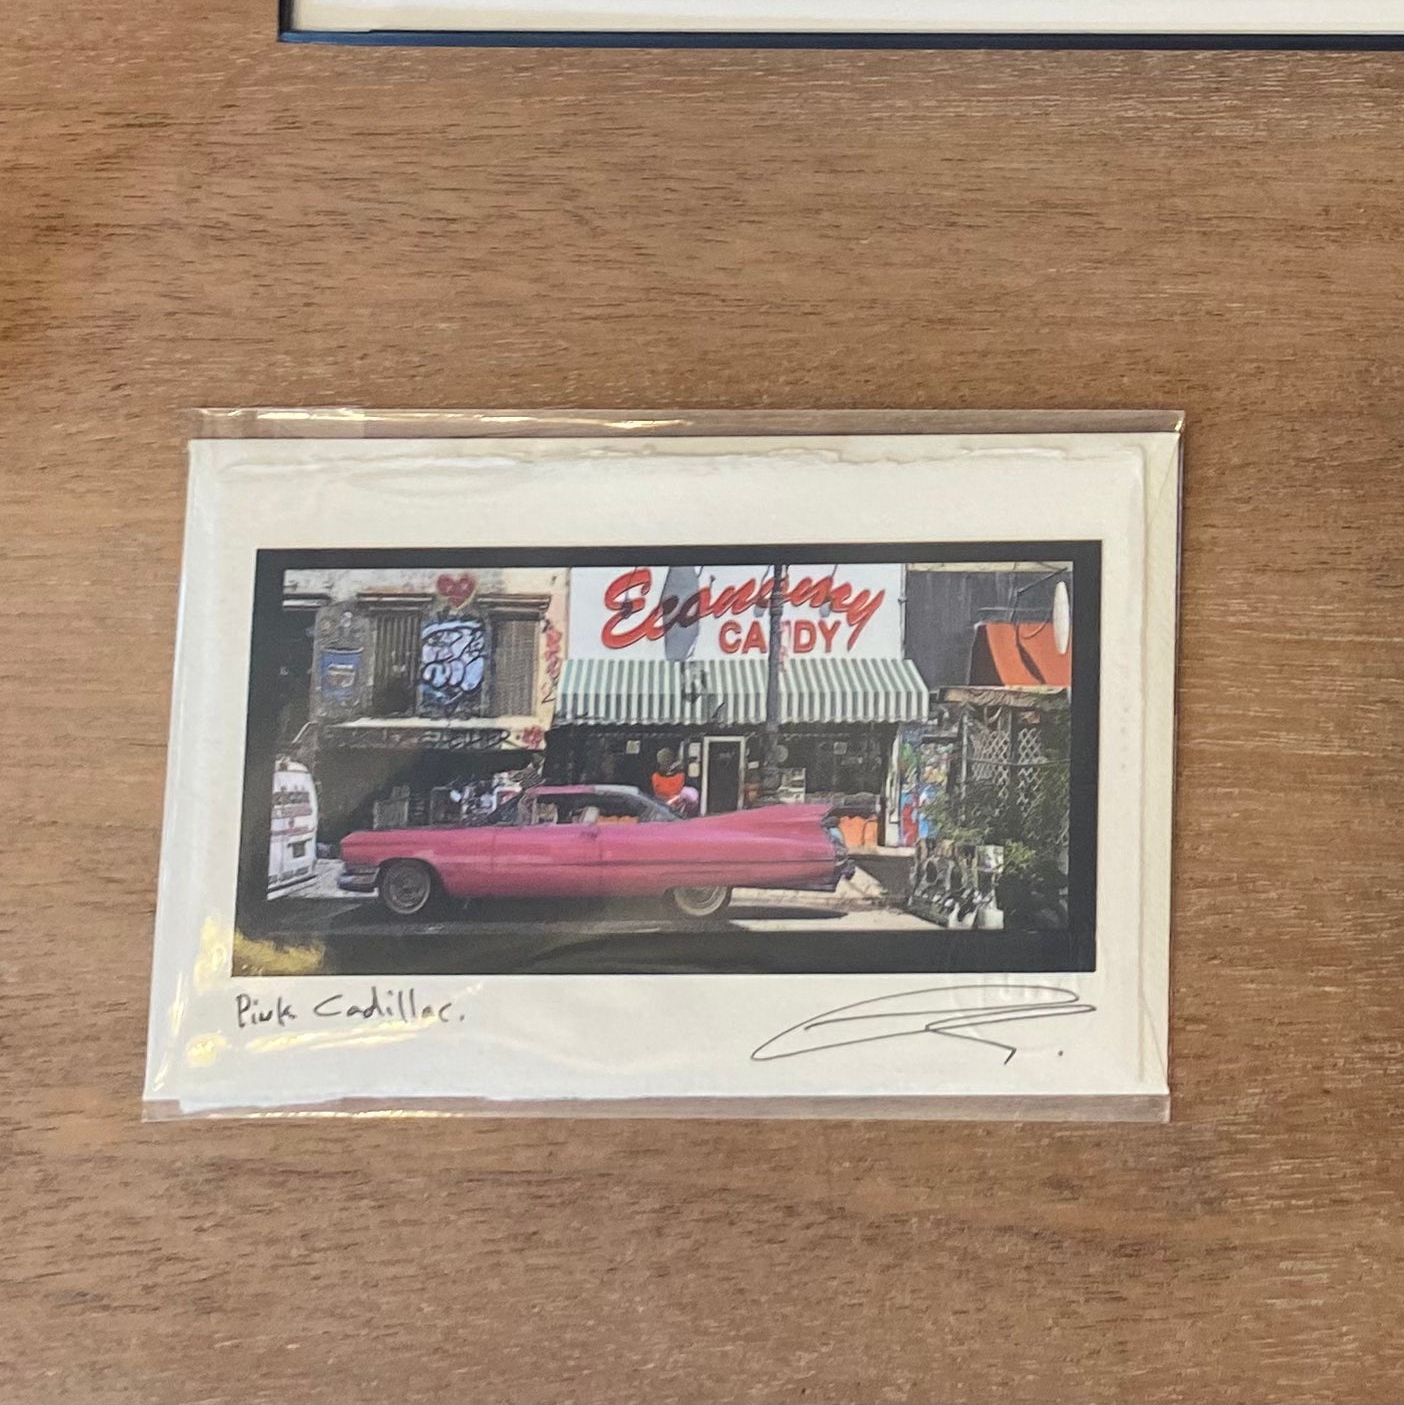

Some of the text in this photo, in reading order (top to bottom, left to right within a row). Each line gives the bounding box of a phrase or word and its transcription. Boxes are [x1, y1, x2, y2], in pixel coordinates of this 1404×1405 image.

[717, 619, 842, 655] CADY
[235, 985, 466, 1029] Pink Cadillac.
